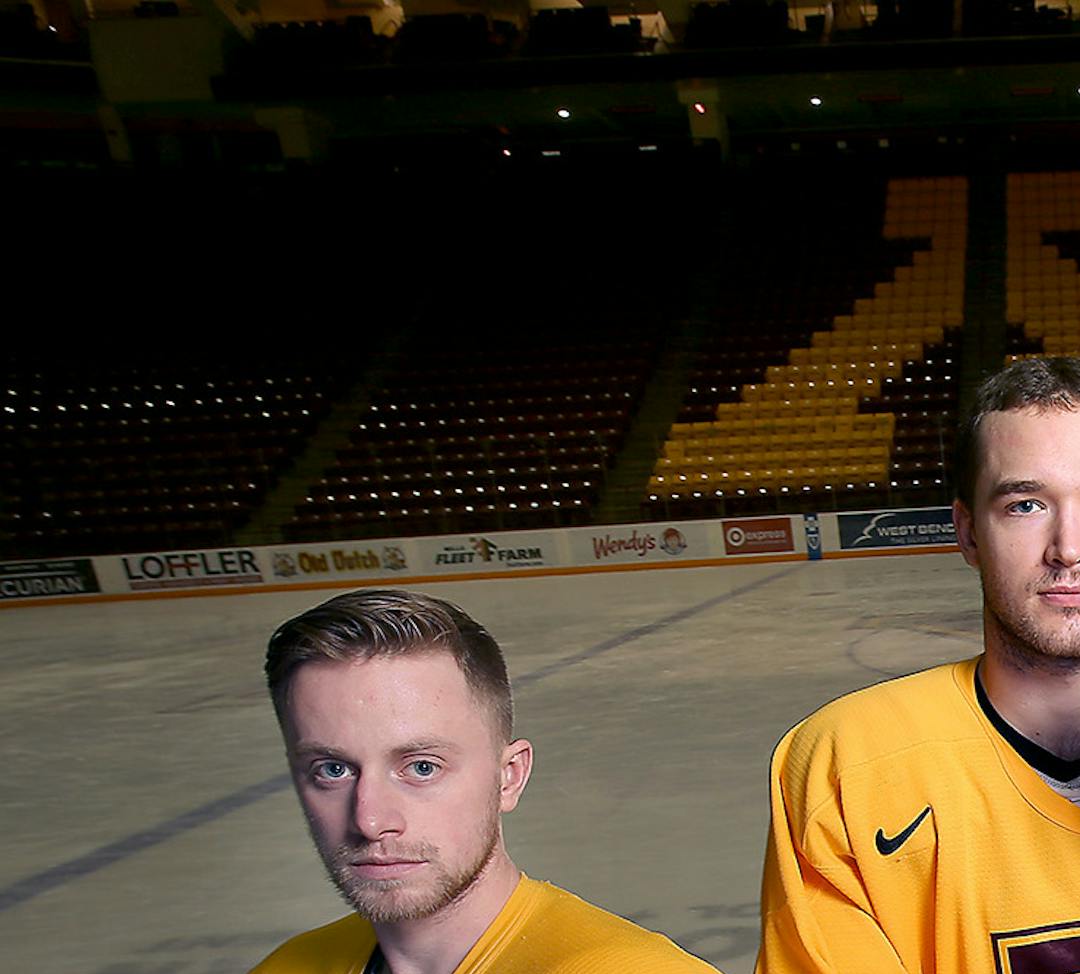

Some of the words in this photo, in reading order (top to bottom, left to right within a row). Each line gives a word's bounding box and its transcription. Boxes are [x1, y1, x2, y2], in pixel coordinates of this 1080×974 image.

[877, 526, 915, 537] WEST
[436, 552, 475, 564] FLEET
[497, 547, 542, 561] FARM
[592, 530, 656, 560] Wendy's
[121, 551, 260, 581] LOFFLER
[297, 552, 328, 574] Old
[0, 576, 84, 597] CURIAN
